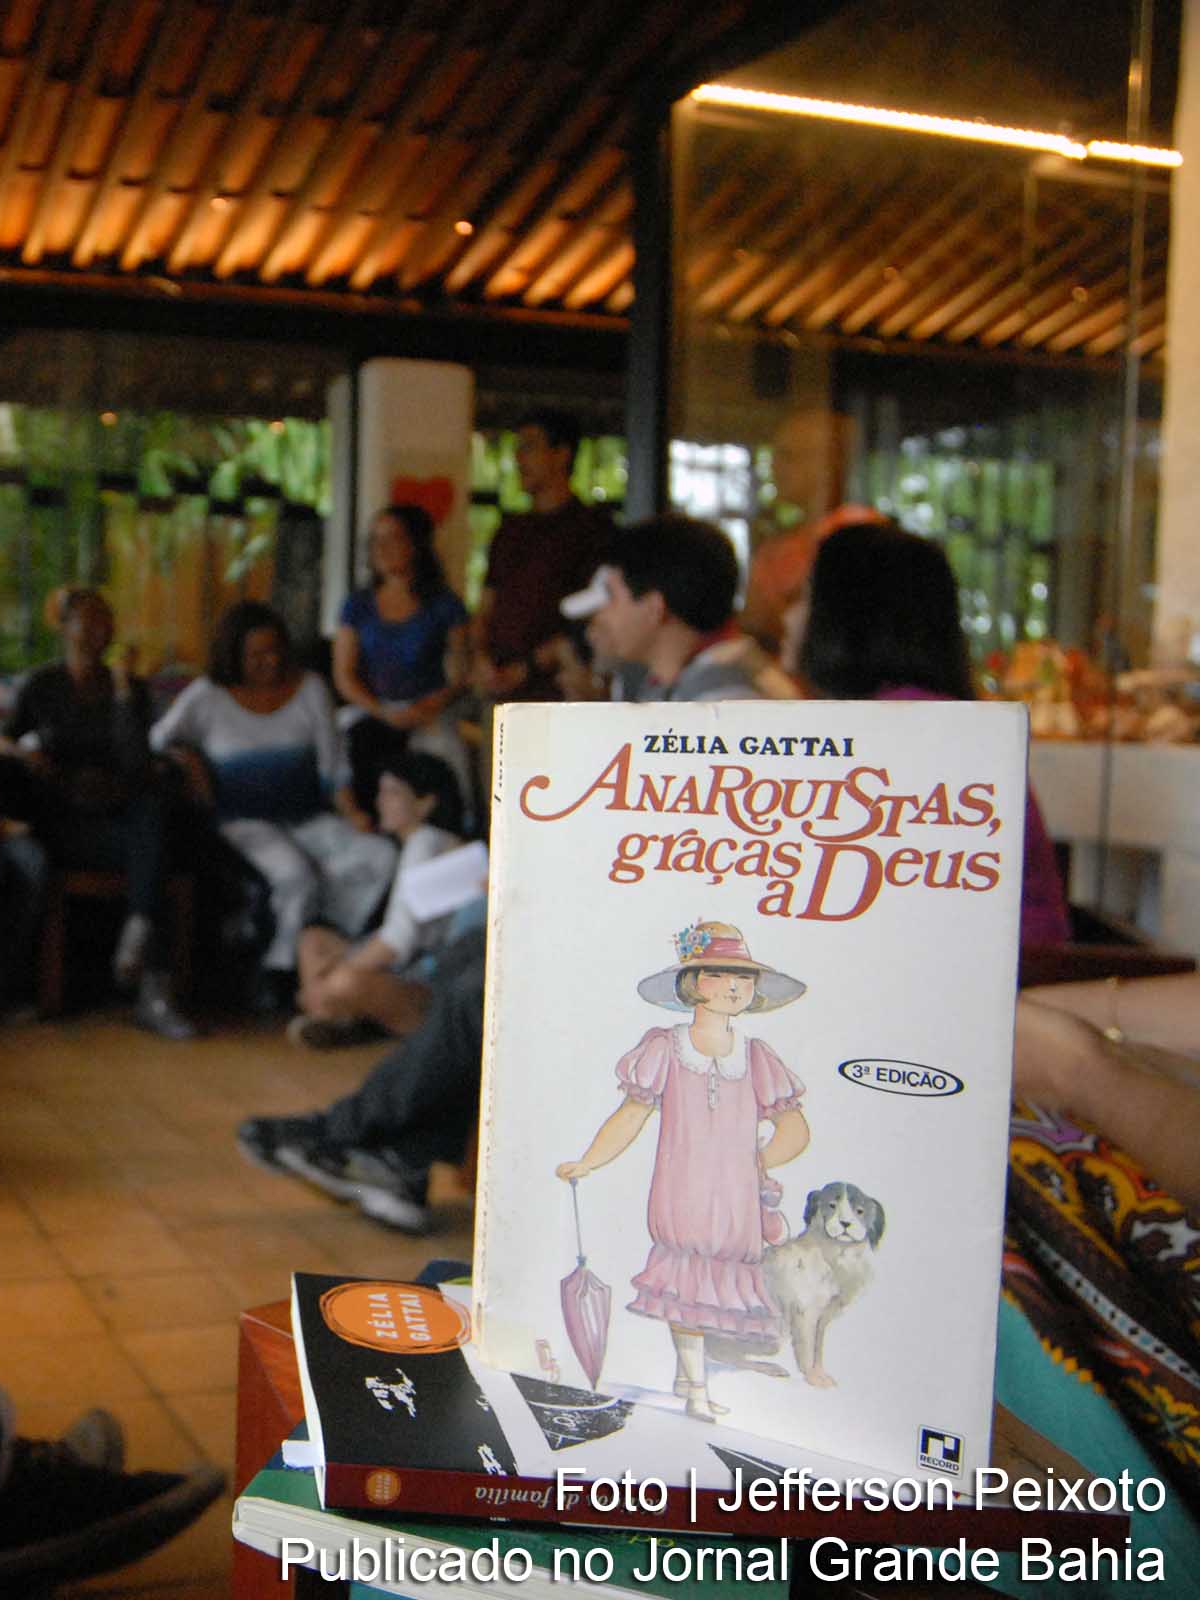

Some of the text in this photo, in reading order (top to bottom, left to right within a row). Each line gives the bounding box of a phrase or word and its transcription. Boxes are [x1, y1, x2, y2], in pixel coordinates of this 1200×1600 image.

[643, 728, 855, 758] ZÉLIA GATTAI
[608, 827, 802, 886] graças
[757, 842, 1002, 923] a Deus
[875, 1067, 948, 1091] EDIÇÃO
[367, 1292, 399, 1340] ZÉLIA
[399, 1293, 432, 1342] GATTAI
[919, 1454, 960, 1472] RECORD
[475, 1486, 554, 1509] família
